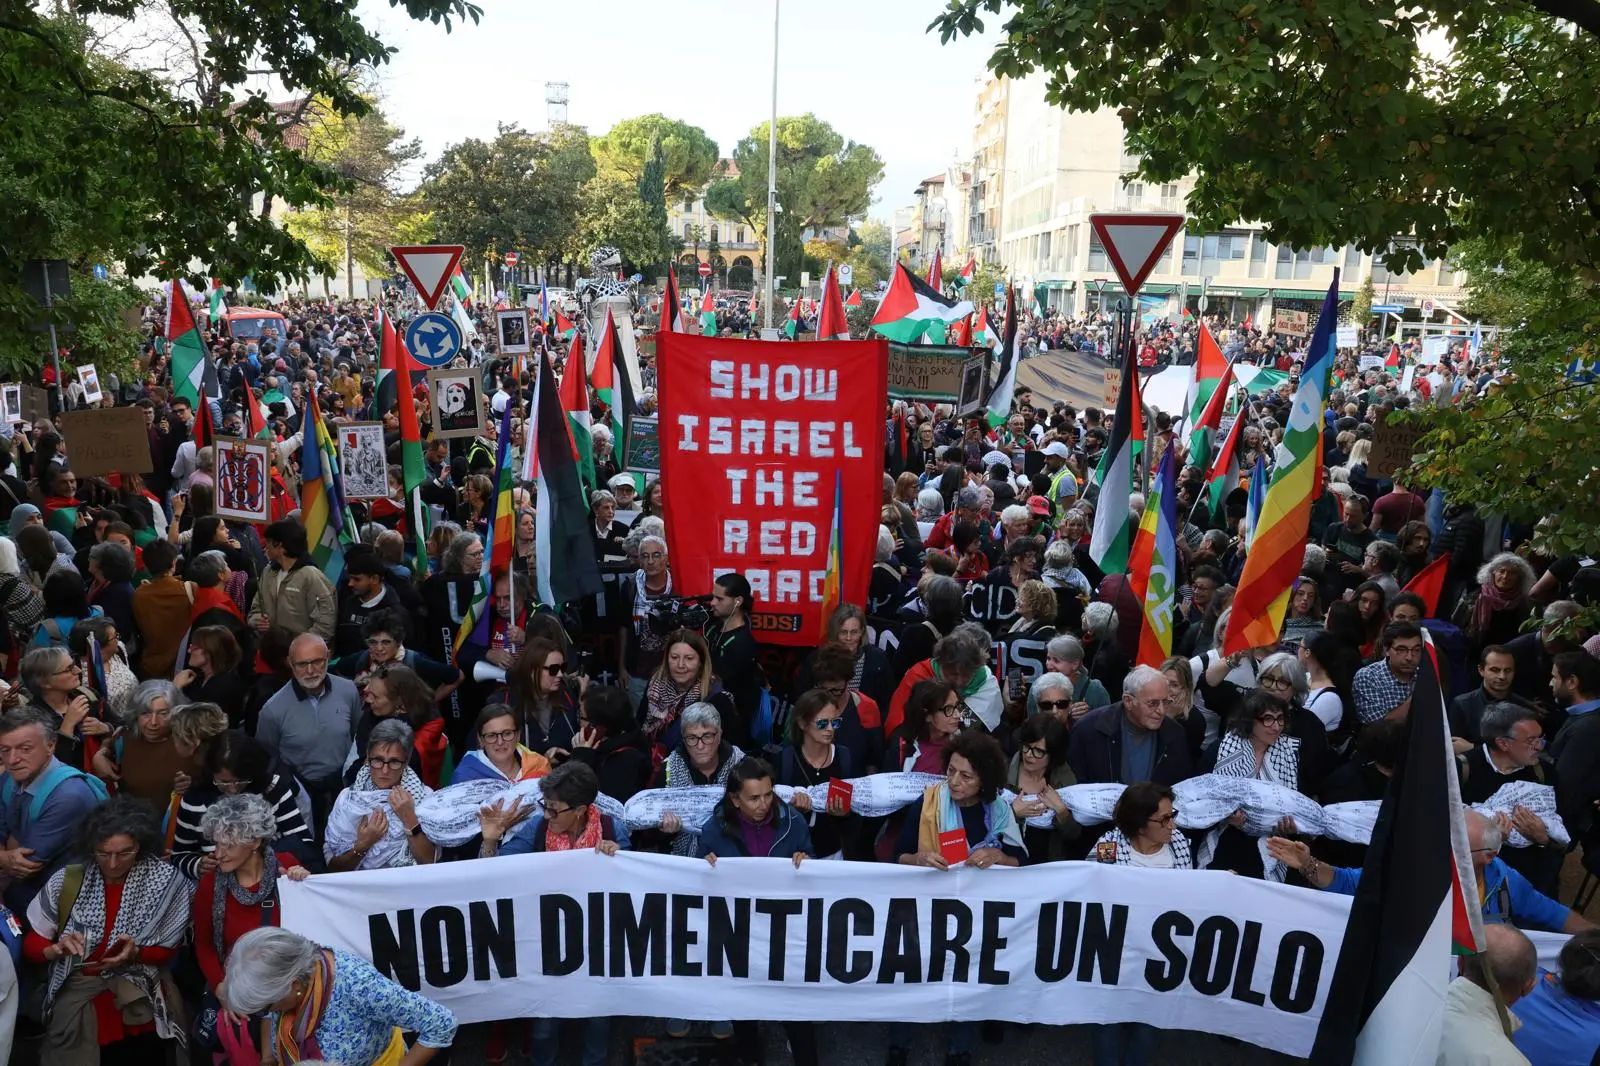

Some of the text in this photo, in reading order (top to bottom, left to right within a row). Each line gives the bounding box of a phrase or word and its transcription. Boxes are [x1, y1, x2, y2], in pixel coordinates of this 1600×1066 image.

[710, 360, 838, 402] SHOW
[908, 366, 928, 377] NON
[677, 415, 863, 458] ISRAEL
[726, 469, 819, 507] THE
[723, 519, 817, 556] RED
[368, 892, 1325, 1014] NON DIMENTICARE UN SOLO
